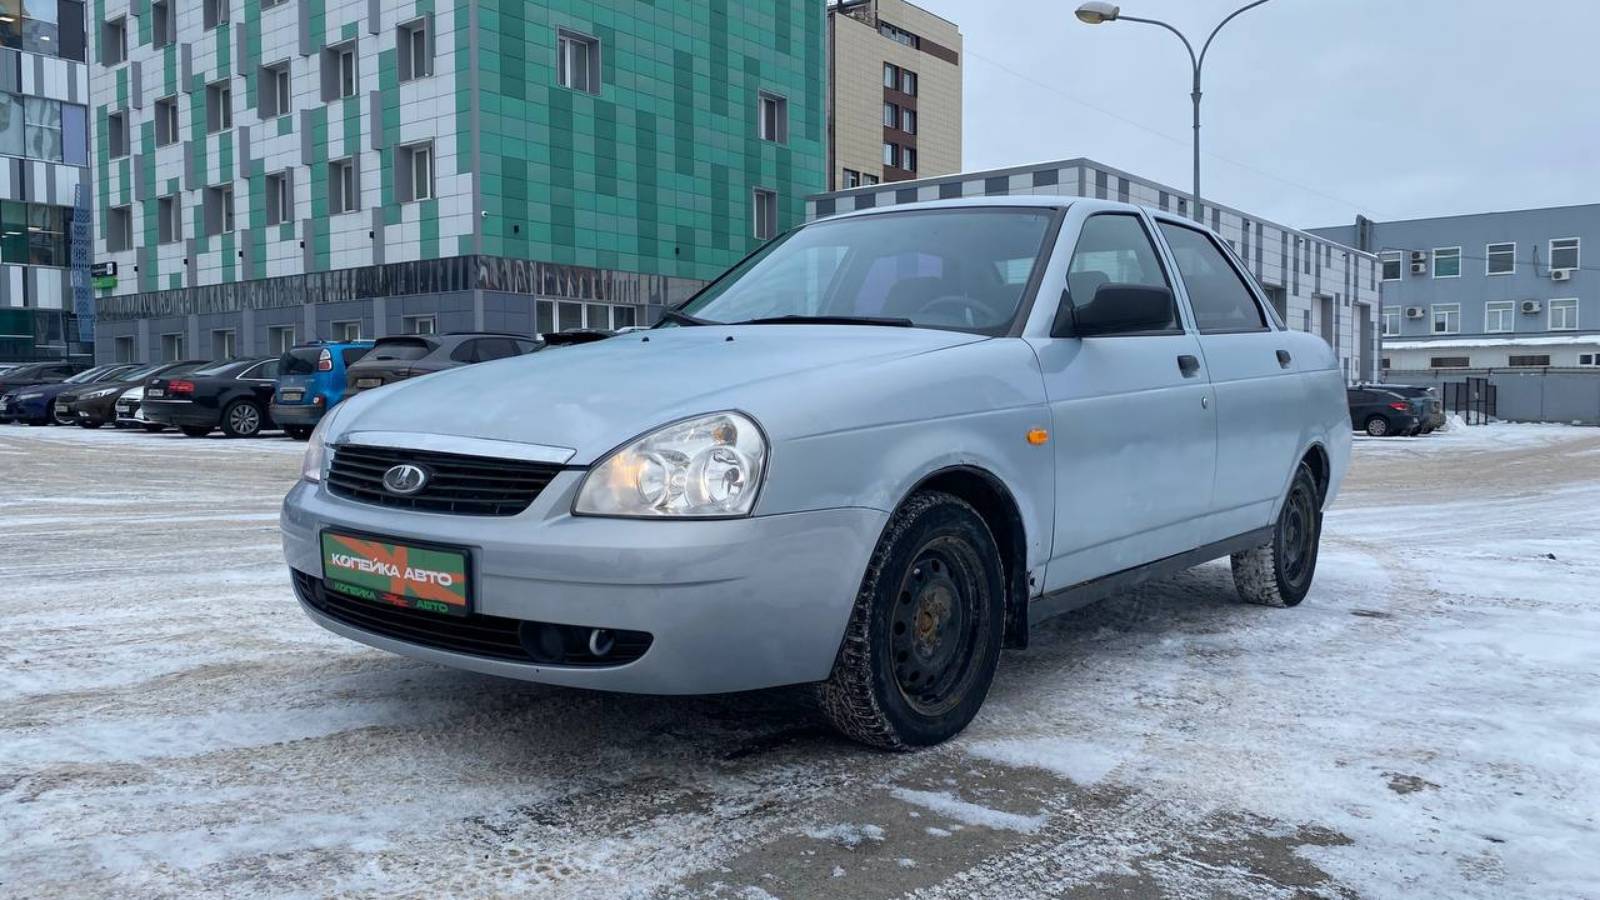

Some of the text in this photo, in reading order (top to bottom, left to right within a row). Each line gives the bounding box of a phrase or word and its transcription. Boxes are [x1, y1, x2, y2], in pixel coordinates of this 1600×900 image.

[331, 552, 452, 586] КОПЕЙКА АВТО
[415, 599, 449, 613] АВТО
